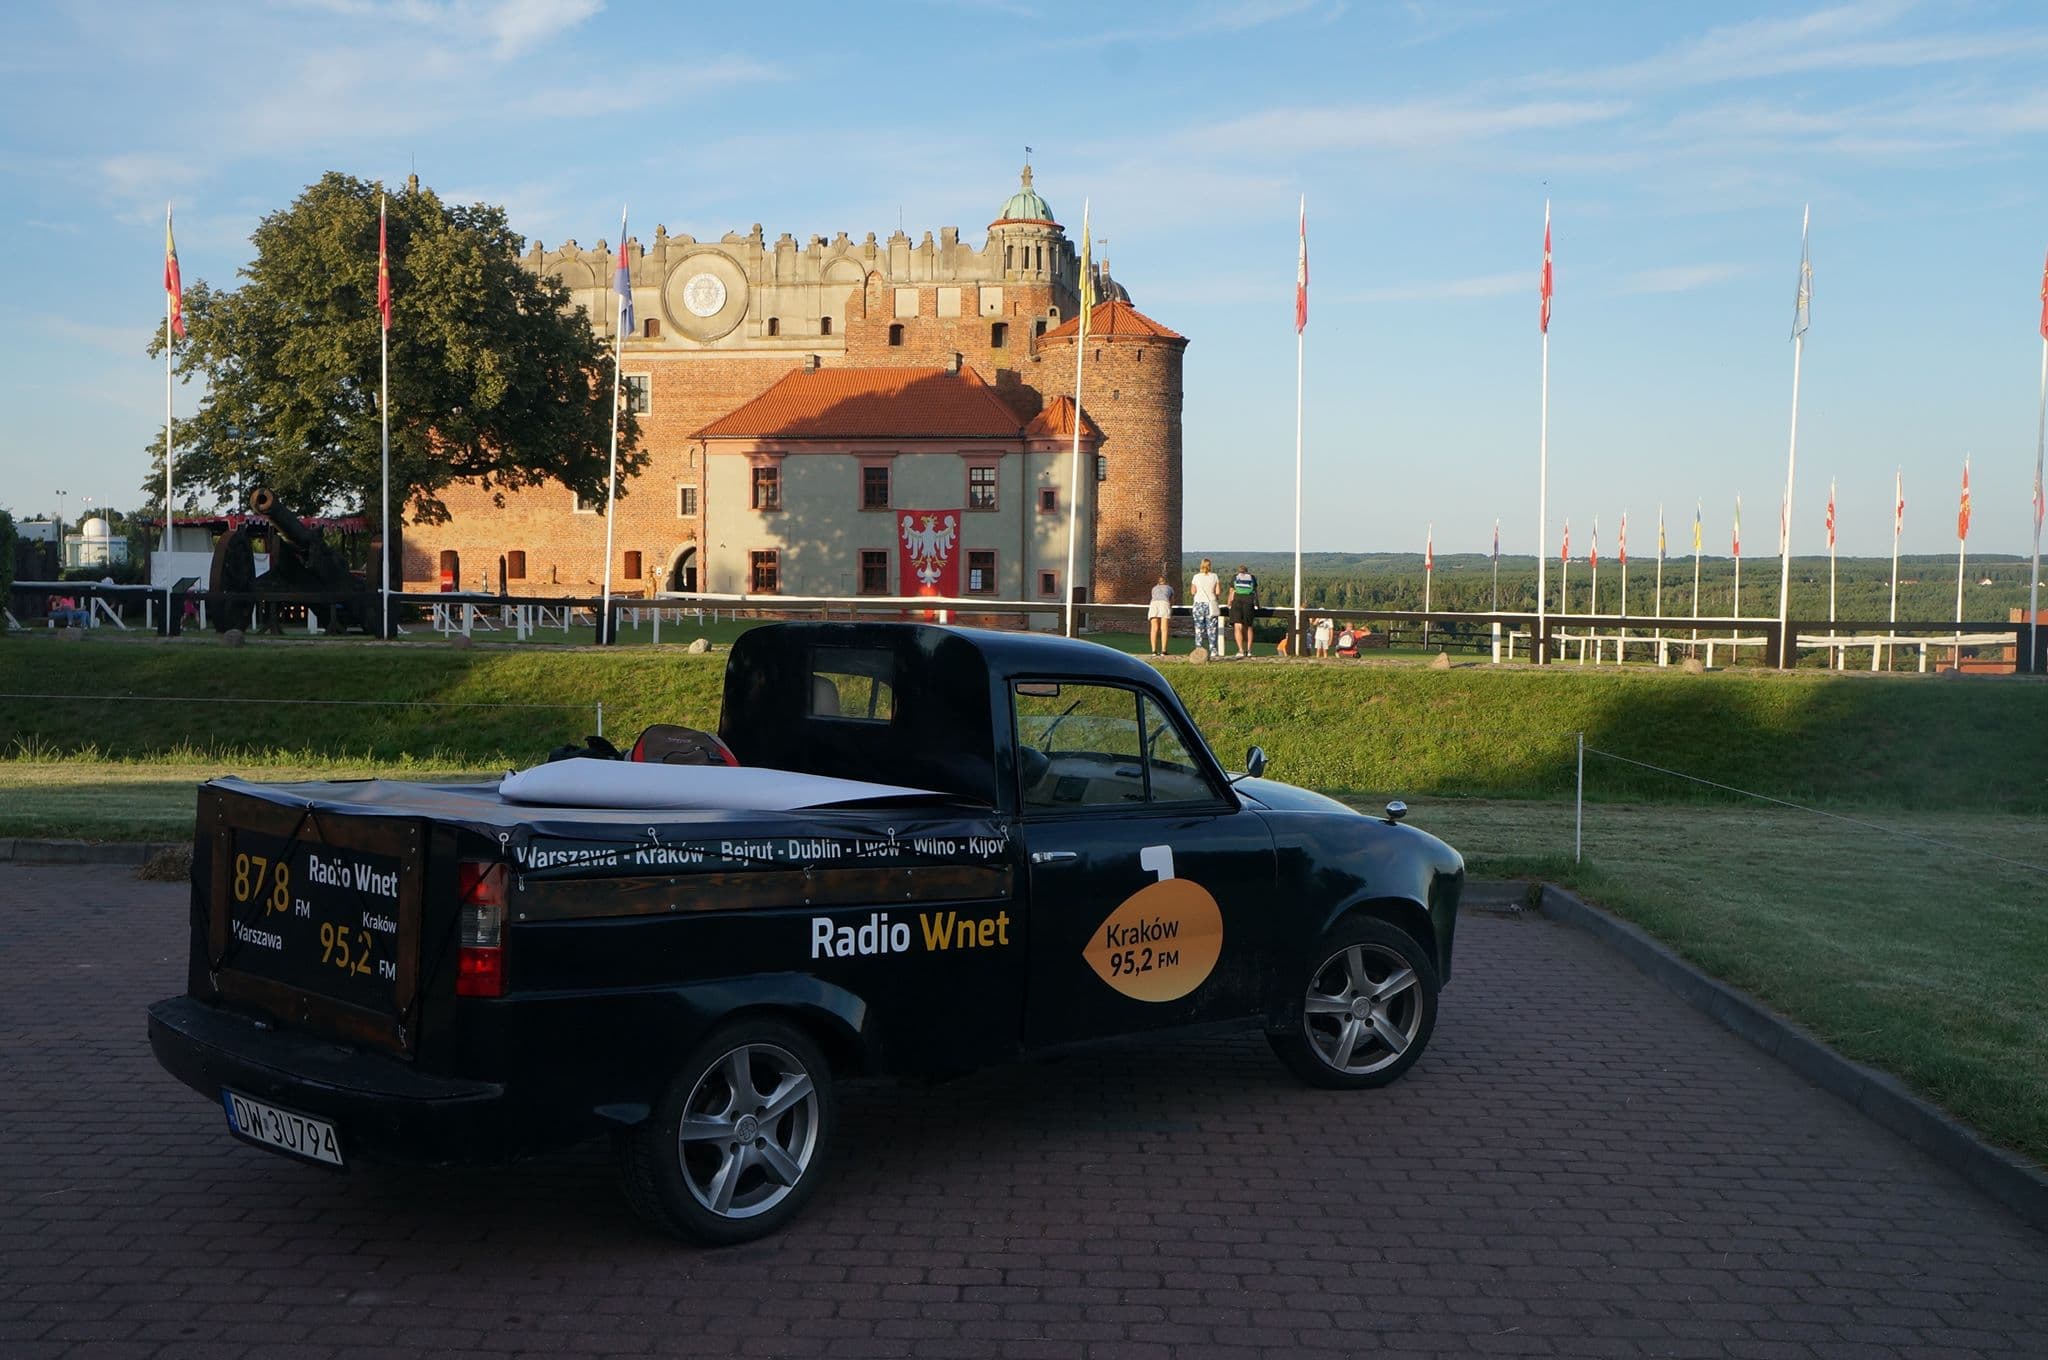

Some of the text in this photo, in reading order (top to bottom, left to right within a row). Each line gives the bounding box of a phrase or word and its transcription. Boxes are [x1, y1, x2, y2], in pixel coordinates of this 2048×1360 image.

[517, 846, 617, 869] Warszawa
[636, 842, 704, 866] Kraków
[721, 840, 774, 866] Bejrut
[789, 839, 841, 860] Dublin
[913, 837, 956, 857] Wilno
[234, 853, 310, 919] 87,8 FM
[309, 854, 398, 898] Radio Wnet
[232, 919, 282, 950] Warszawa
[362, 911, 397, 934] Kraków
[811, 910, 1010, 960] Radio Wnet
[1106, 917, 1179, 949] Kraków
[320, 921, 396, 982] 95,2 FM
[1110, 947, 1179, 977] 95,2 FM
[268, 1111, 339, 1162] 3U794
